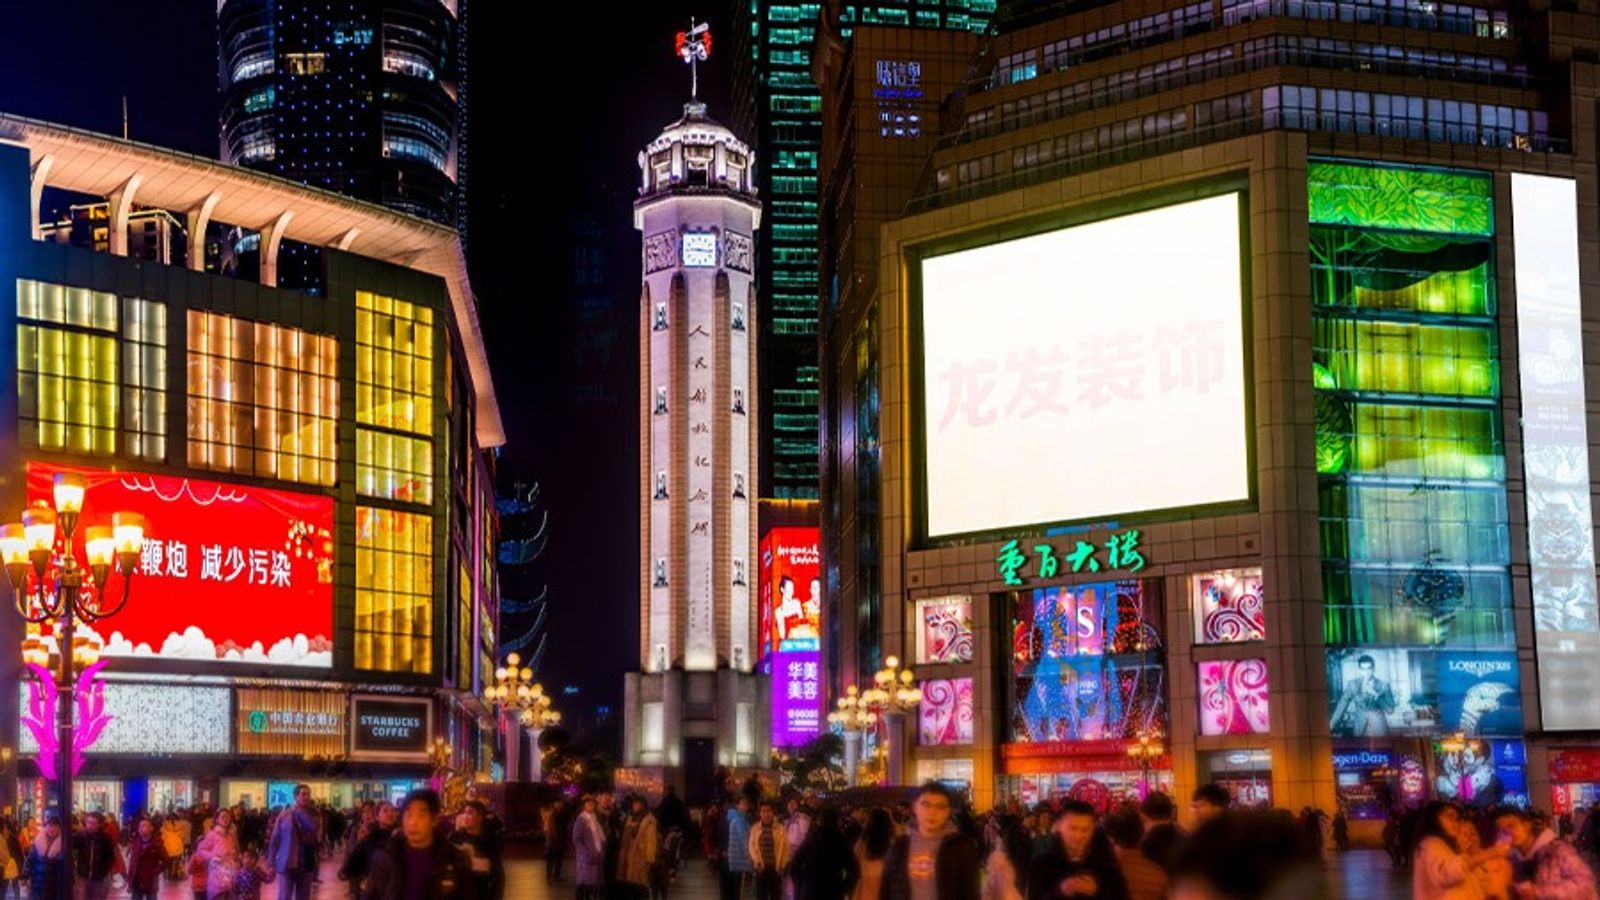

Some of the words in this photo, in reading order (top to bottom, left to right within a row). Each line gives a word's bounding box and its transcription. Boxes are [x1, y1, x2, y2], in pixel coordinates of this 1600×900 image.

[938, 319, 1225, 433] 龙发装饰
[115, 537, 189, 578] 鞭炮
[200, 543, 292, 588] 减少污染
[996, 529, 1145, 585] 重百大楼
[1077, 606, 1095, 638] S
[788, 661, 818, 680] 华美
[1448, 660, 1512, 672] LONGINES
[788, 680, 818, 700] 美容
[360, 715, 420, 728] STARBUCKS
[371, 726, 409, 737] COFFEE
